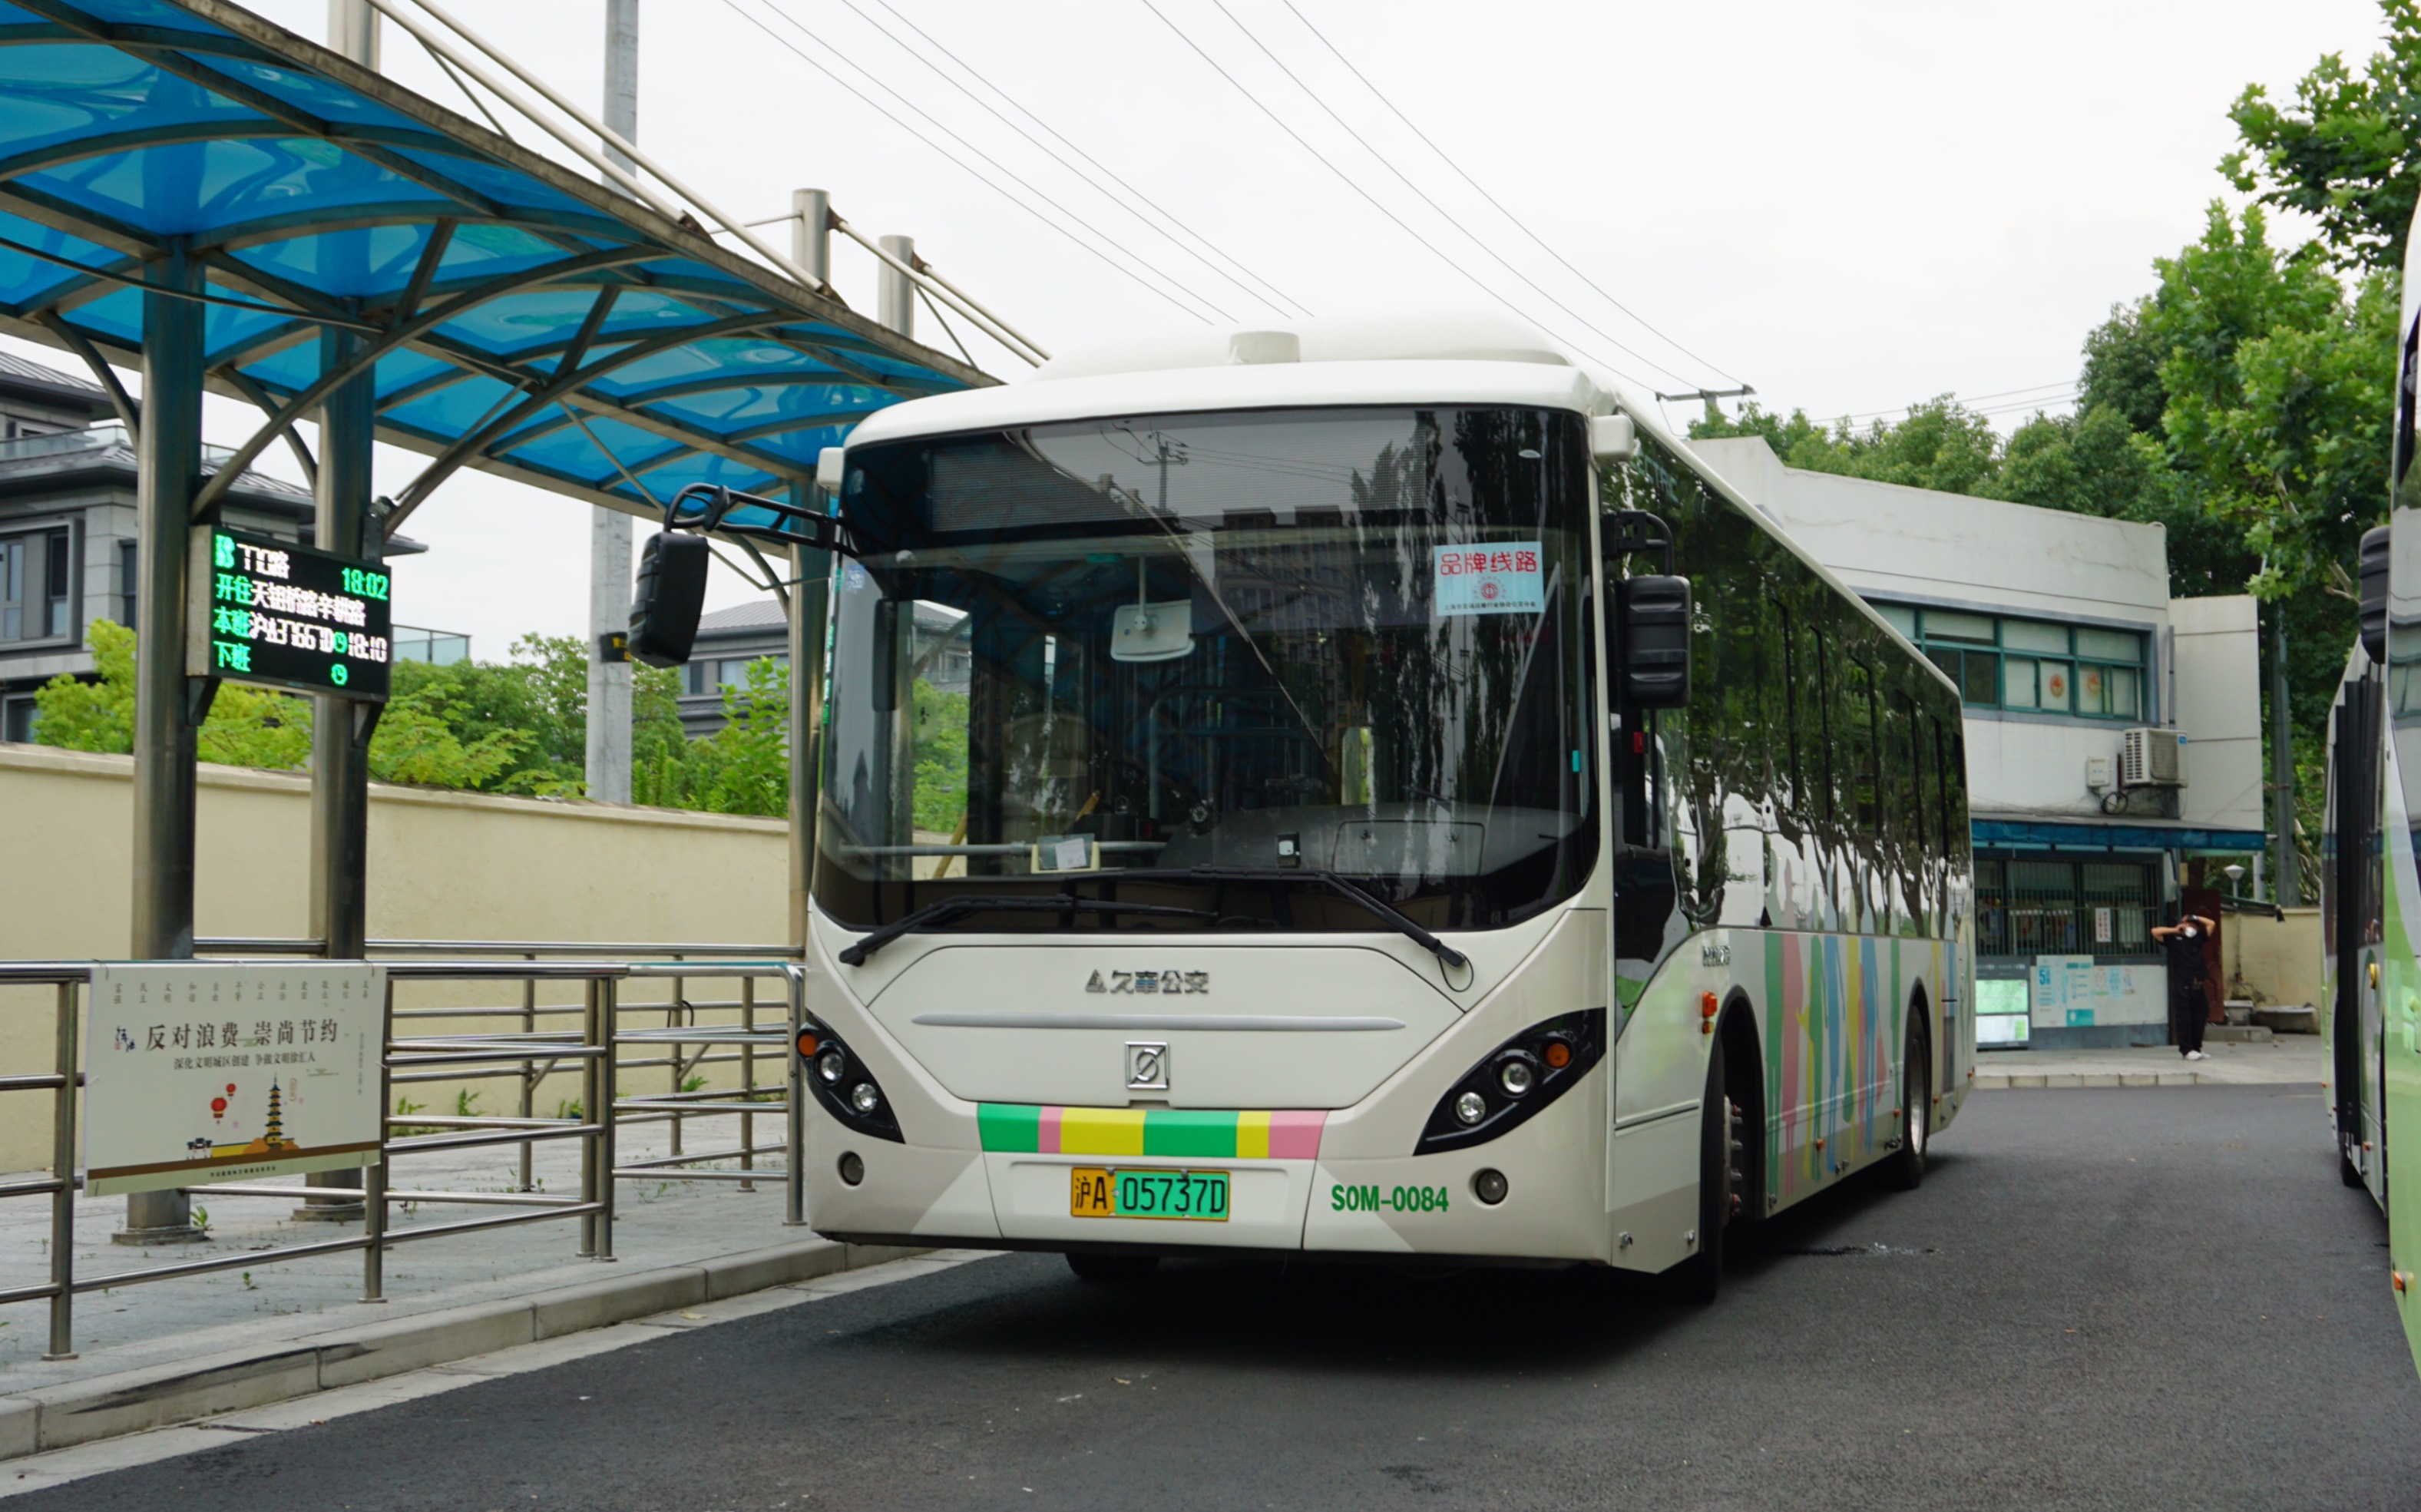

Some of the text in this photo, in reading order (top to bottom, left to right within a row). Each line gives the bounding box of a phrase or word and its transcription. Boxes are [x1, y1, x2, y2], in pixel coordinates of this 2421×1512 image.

[1440, 551, 1538, 576] 品牌线路
[342, 567, 389, 600] 18:02
[213, 640, 252, 673] 下班
[348, 634, 388, 663] 18:10
[146, 1018, 338, 1051] 反对浪费 崇尚节约
[174, 1051, 316, 1070] 深化文明城区创建 争做文明徐汇人
